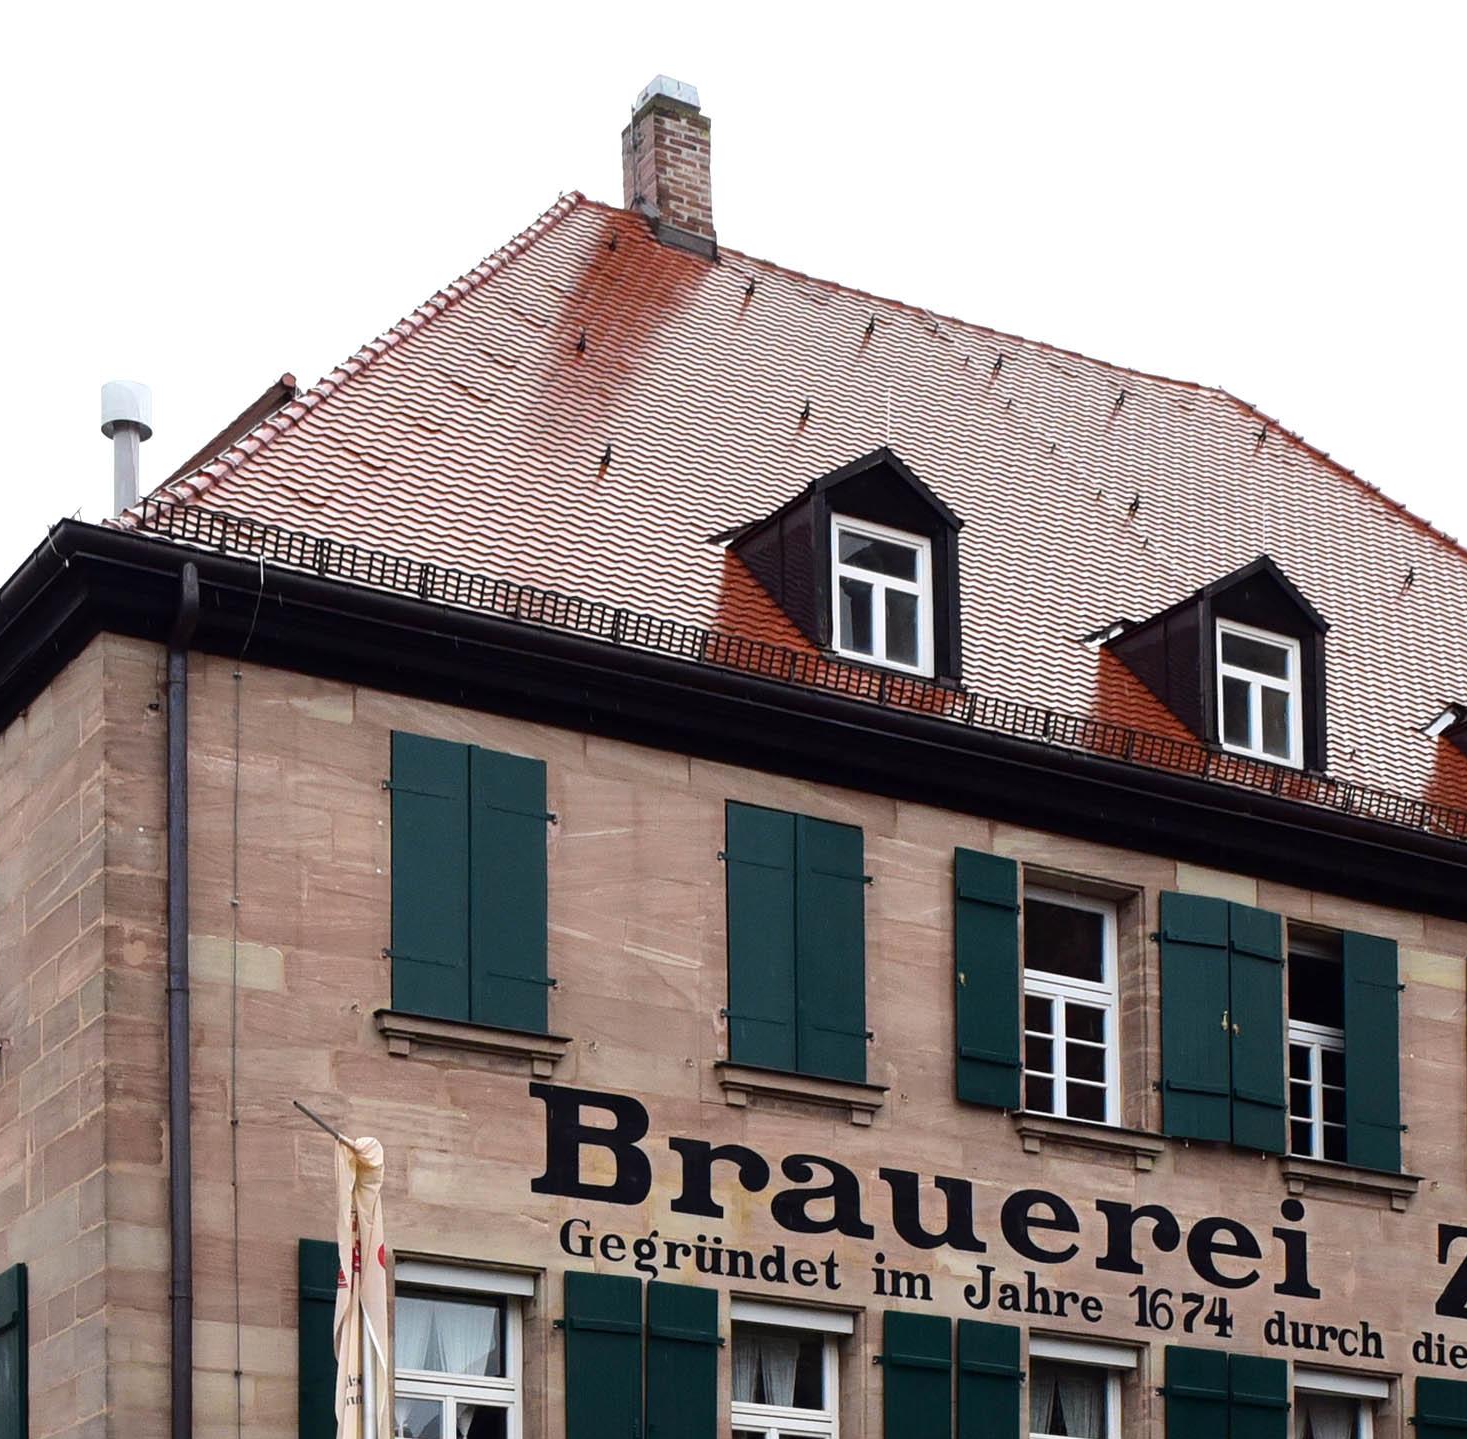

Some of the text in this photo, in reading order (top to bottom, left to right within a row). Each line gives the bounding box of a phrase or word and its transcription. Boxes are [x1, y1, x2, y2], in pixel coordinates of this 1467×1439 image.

[528, 1081, 1321, 1300] Brauerei
[559, 1218, 842, 1290] Gegründet
[872, 1252, 933, 1301] im
[963, 1264, 1103, 1323] Jahre
[1129, 1285, 1234, 1339] 1674
[1263, 1310, 1385, 1360] durch
